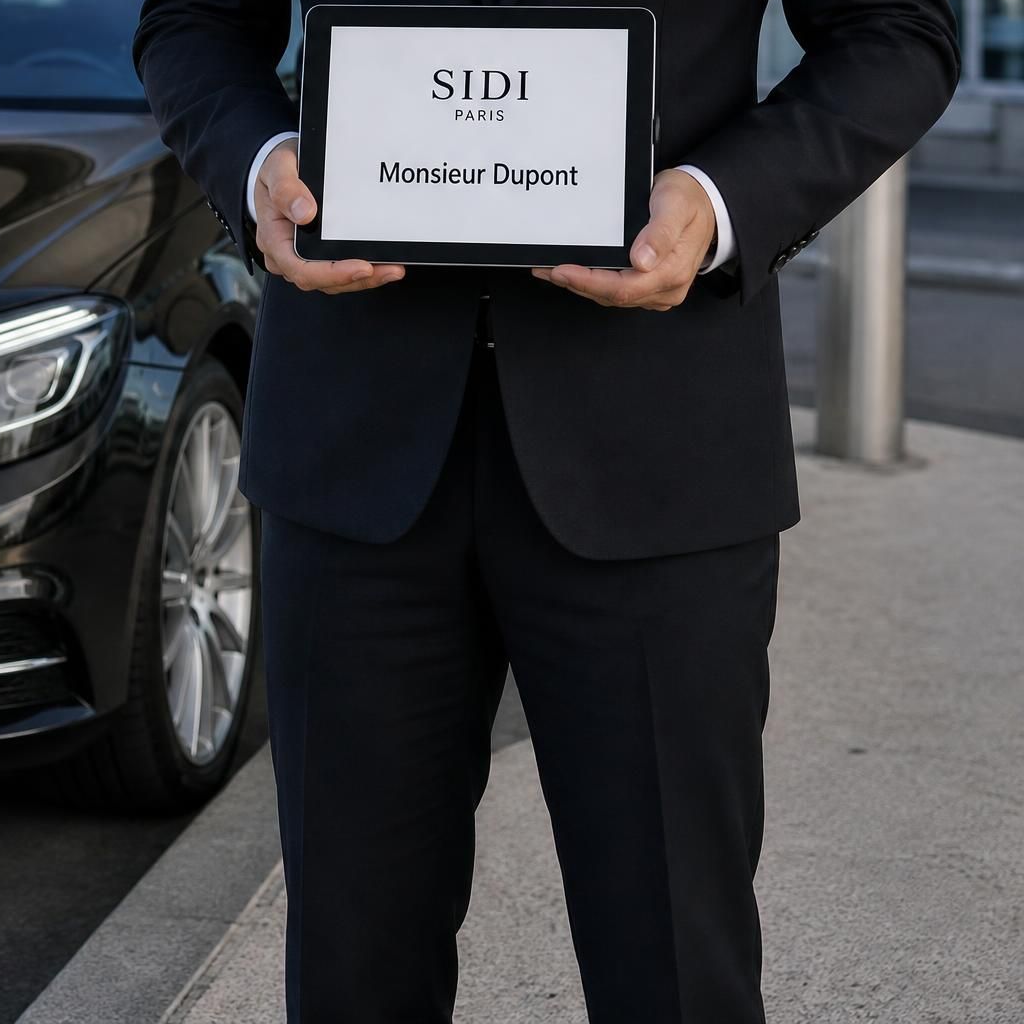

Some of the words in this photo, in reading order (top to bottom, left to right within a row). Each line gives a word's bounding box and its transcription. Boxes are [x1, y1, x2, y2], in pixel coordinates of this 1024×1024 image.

[431, 68, 530, 101] SIDI
[454, 109, 505, 122] PARIS
[378, 160, 487, 186] Monsieur
[493, 162, 579, 191] Dupont
